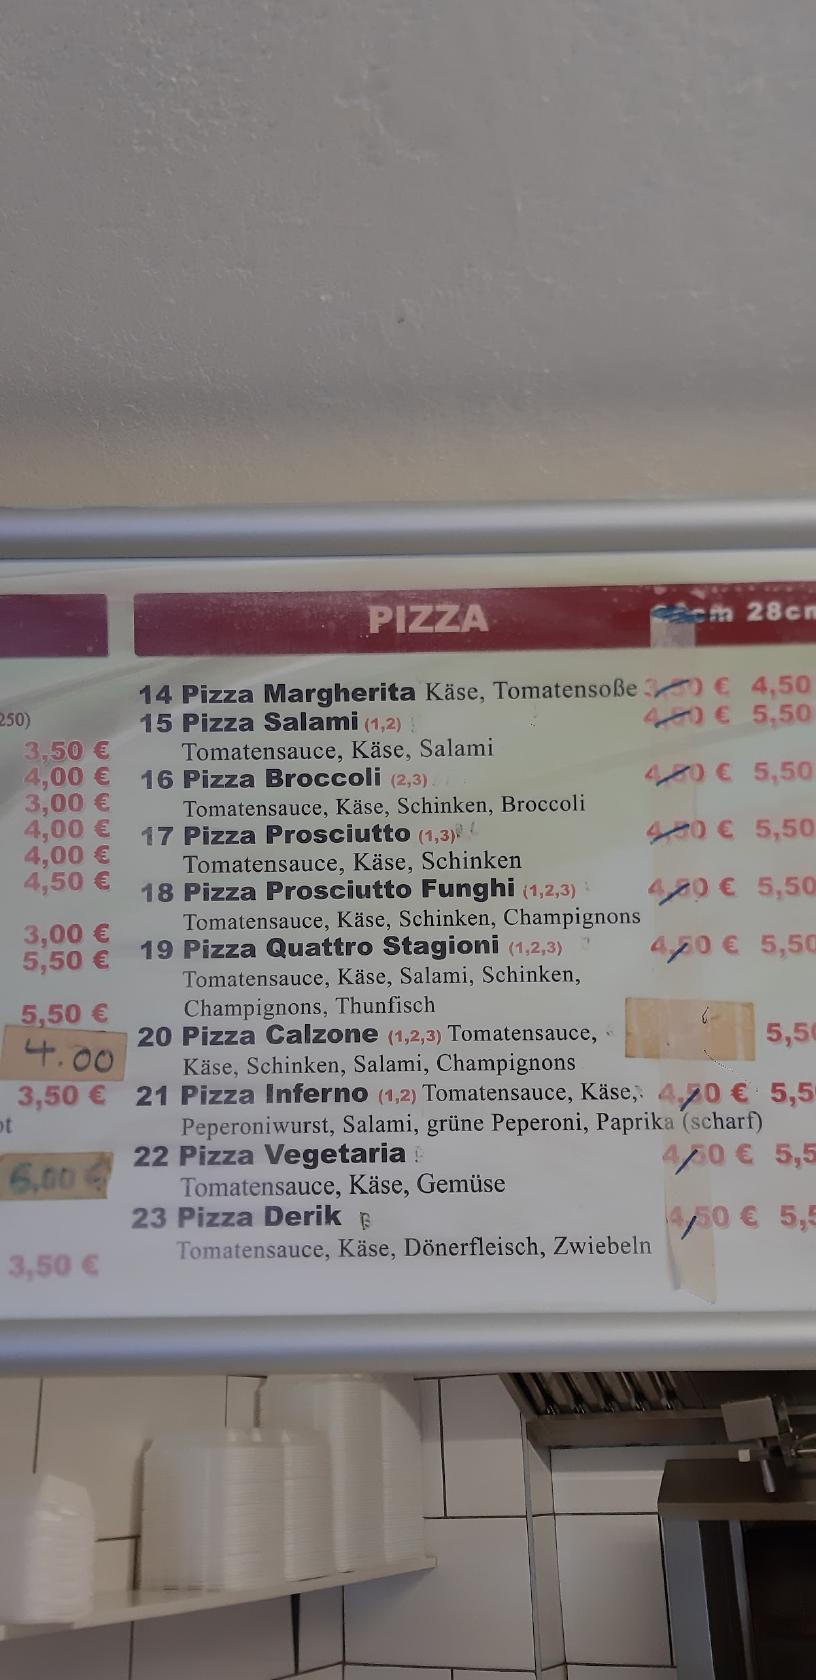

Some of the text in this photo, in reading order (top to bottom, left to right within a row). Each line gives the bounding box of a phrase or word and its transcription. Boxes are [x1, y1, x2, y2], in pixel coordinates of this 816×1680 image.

[369, 604, 489, 634] PIZZA
[139, 678, 638, 708] 14 Pizza Margherita Käse, Tomatensoße
[714, 677, 730, 696] €
[752, 675, 811, 699] 4,50
[139, 711, 402, 733] 15 Pizza Salami (1,2)
[714, 705, 730, 725] €
[752, 704, 812, 728] 5,50
[24, 740, 110, 764] 3,50 €
[182, 738, 494, 763] Tomatensauce, Käse, Salami
[24, 766, 110, 790] 4,00 €
[141, 767, 428, 789] 16 Pizza Broccoli (2,3)
[716, 762, 732, 782] €
[754, 761, 813, 785] 5,50
[24, 793, 110, 816] 3,00 €
[183, 793, 586, 818] Tomatensauce, Käse, Schinken, Broccoli
[24, 819, 110, 843] 4,00 €
[141, 826, 174, 846] 17
[184, 826, 256, 846] Pizza
[266, 823, 411, 845] Prosciutto
[418, 829, 456, 845] (1,3)
[717, 819, 733, 840] €
[755, 818, 816, 841] 5,50
[24, 845, 110, 869] 4,00 €
[183, 850, 522, 875] Tomatensauce, Käse, Schinken
[24, 871, 110, 895] 4,50 €
[141, 877, 576, 902] 18 Pizza Prosciutto Funghi (1,2,3)
[719, 877, 736, 897] €
[758, 876, 816, 900] 5,50
[183, 907, 641, 931] Tomatensauce, Käse, Schinken, Champignons
[24, 923, 109, 949] 3,00 €
[140, 934, 562, 961] 19 Pizza Quattro Stagioni (1,2,3)
[722, 934, 739, 955] €
[760, 934, 816, 959] 5,50
[23, 950, 109, 975] 5,50 €
[183, 965, 581, 988] Tomatensauce, Käse, Salami, Schinken,
[21, 1003, 108, 1027] 5,50 €
[184, 995, 436, 1021] Champignons, Thunfisch
[137, 1023, 597, 1047] 20 Pizza Calzone (1,2,3) Tomatensauce,
[766, 1021, 816, 1047] 5,5
[24, 1038, 114, 1073] 4.00
[183, 1052, 576, 1077] Käse, Schinken, Salami, Champignons
[17, 1084, 106, 1110] 3,50 €
[136, 1082, 638, 1106] 21 Pizza Inferno (1,2) Tomatensauce, Käse,
[730, 1082, 748, 1104] €
[770, 1082, 816, 1107] 5,5
[181, 1110, 763, 1140] Peperoniwurst, Salami, grüne Peperoni, Paprika (scharf)
[133, 1145, 169, 1167] 22
[179, 1145, 254, 1166] Pizza
[264, 1142, 406, 1170] Vegetaria
[735, 1143, 753, 1165] €
[181, 1172, 506, 1199] Tomatensauce, Käse, Gemüse
[131, 1204, 342, 1229] 23 Pizza Derik
[739, 1204, 759, 1227] €
[176, 1235, 653, 1261] Tomatensauce, Käse, Dönerfleisch, Zwiebeln
[8, 1253, 99, 1281] 3,50 €
